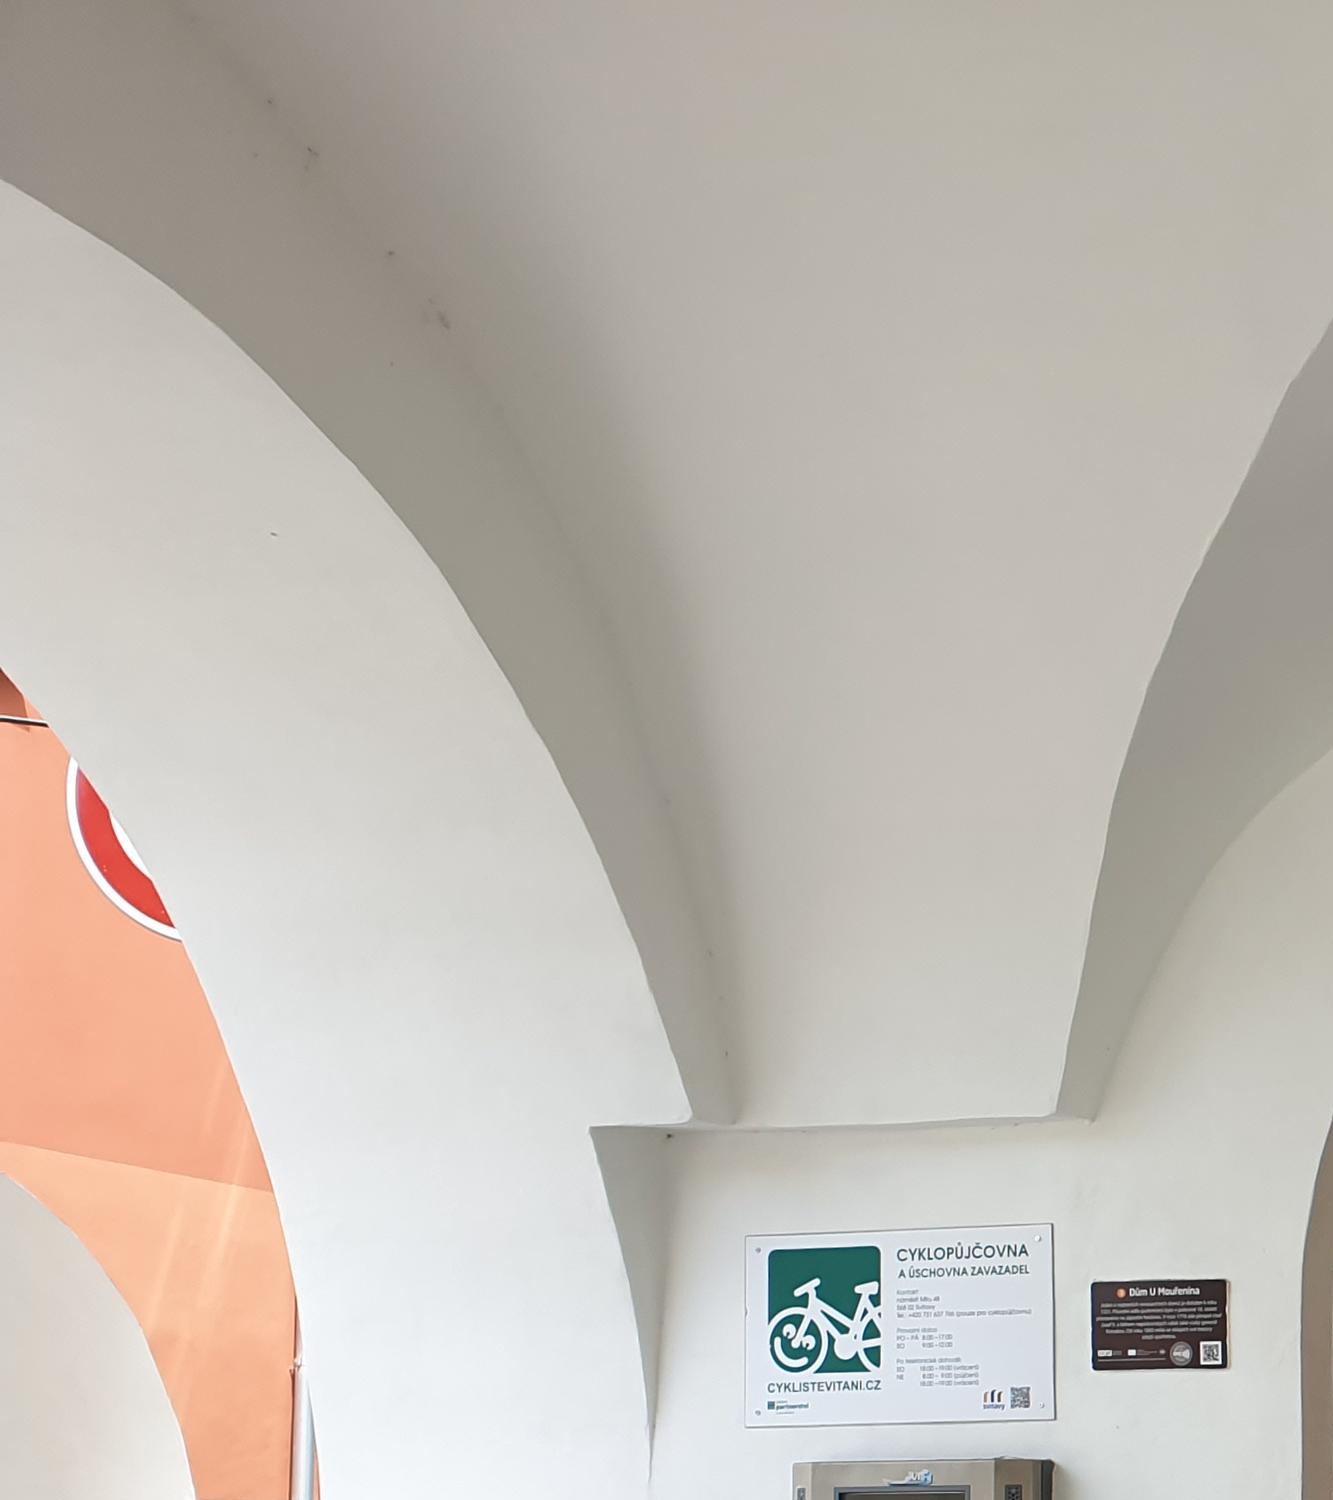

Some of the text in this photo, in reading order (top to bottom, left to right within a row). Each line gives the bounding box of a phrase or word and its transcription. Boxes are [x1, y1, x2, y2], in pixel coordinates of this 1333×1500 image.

[896, 1241, 1029, 1261] CYKLOPŮJČOVNA
[898, 1264, 1030, 1279] A ÚSCHOVNA ZAVAZADEL
[1149, 1287, 1156, 1296] U
[767, 1380, 882, 1394] CYKLISTEVITANI.CZ
